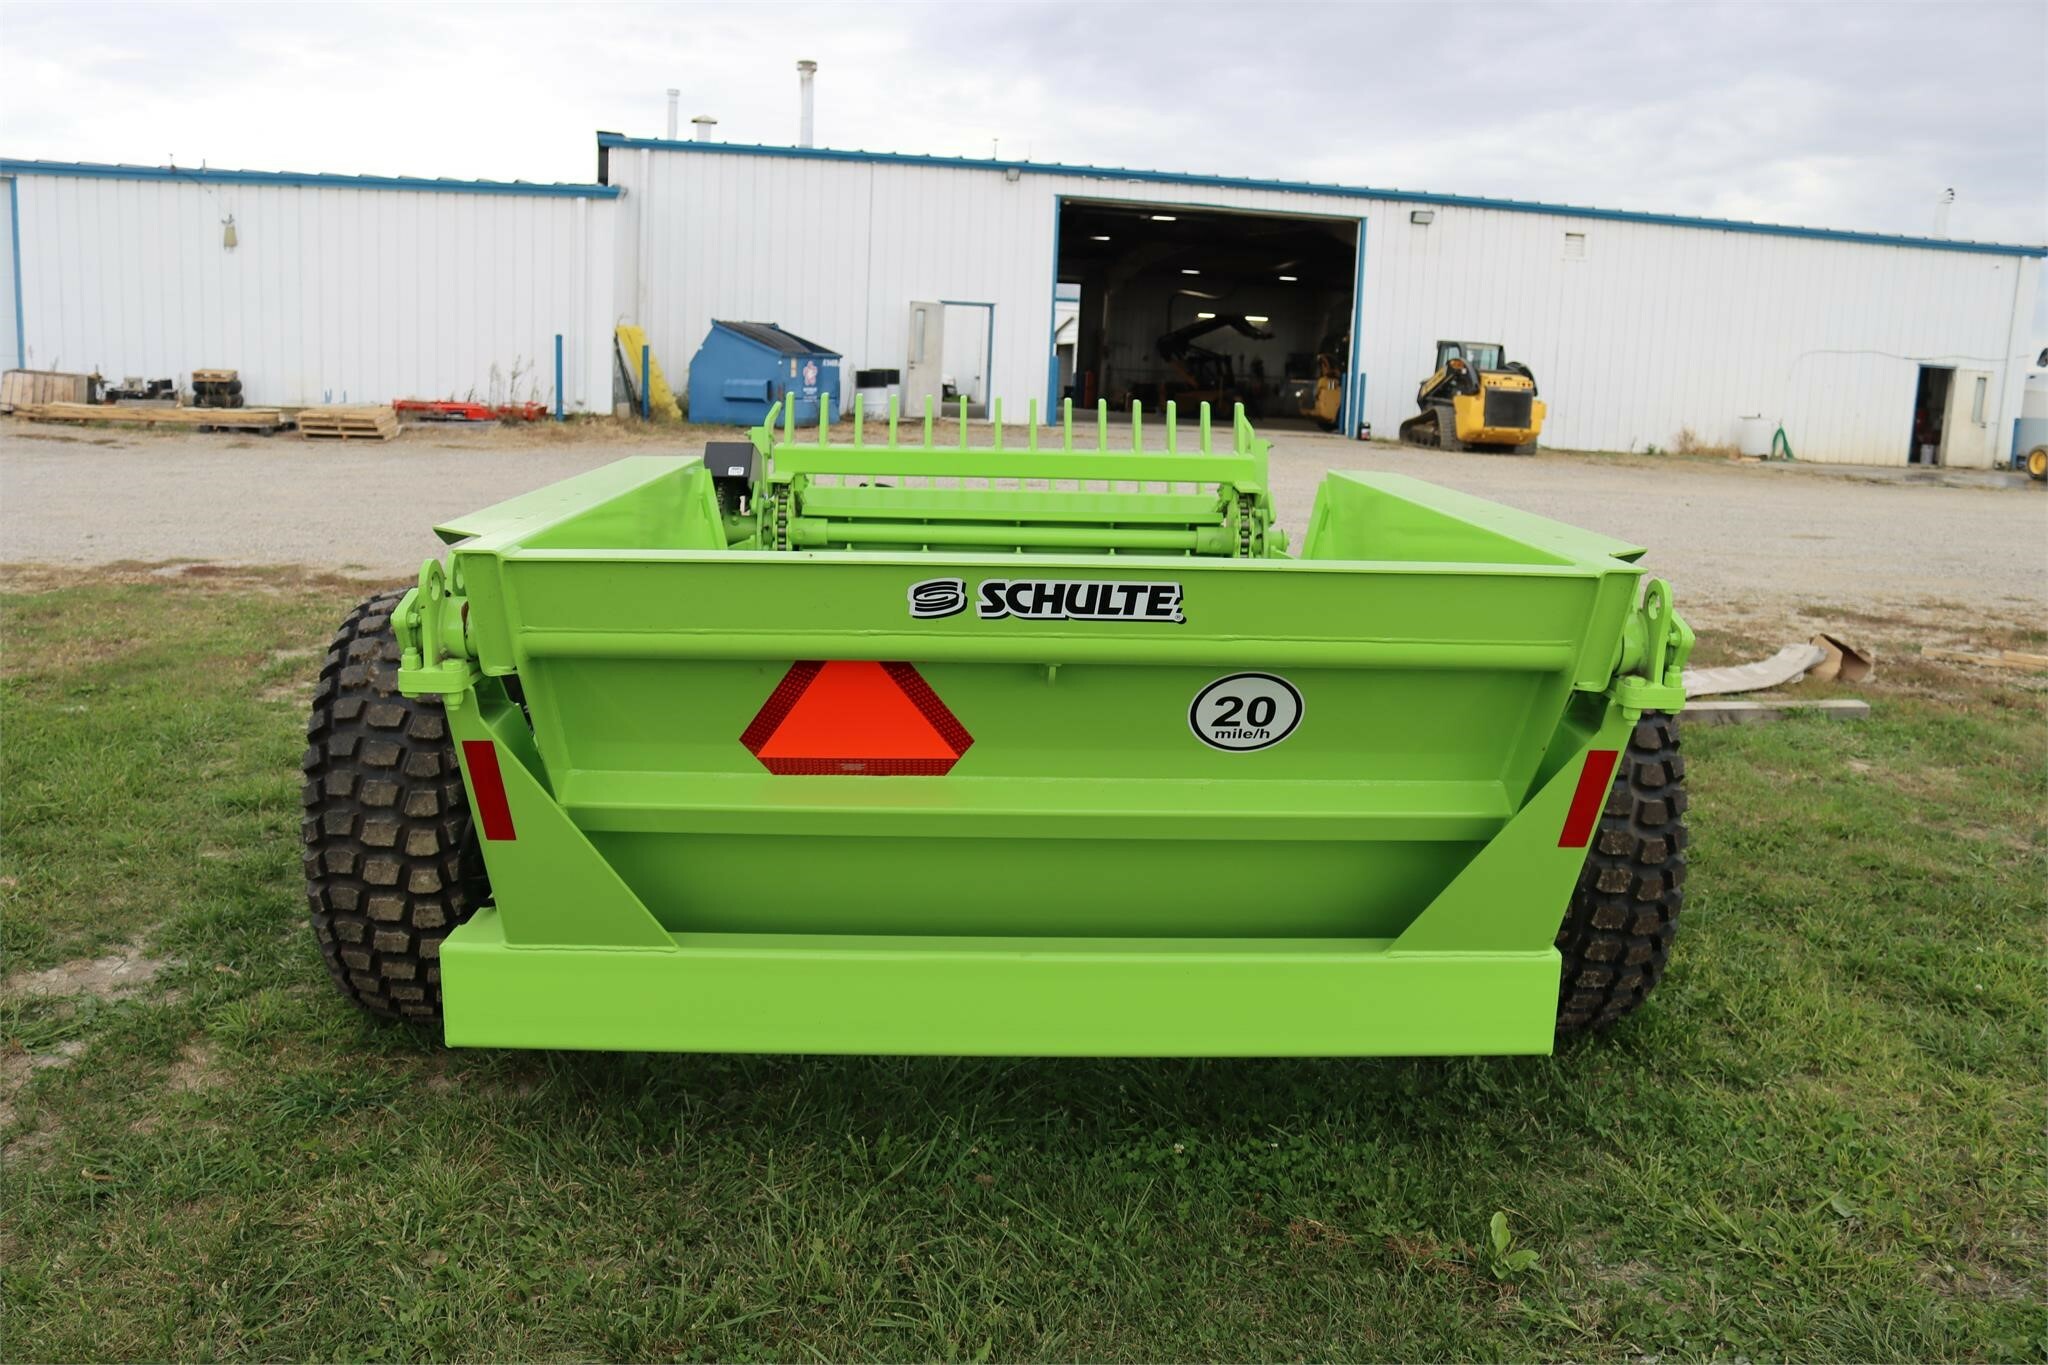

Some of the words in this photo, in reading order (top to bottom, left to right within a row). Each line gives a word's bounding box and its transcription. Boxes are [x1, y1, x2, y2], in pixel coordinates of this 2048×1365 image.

[980, 583, 1176, 616] SCHULTE
[1211, 696, 1277, 727] 20
[1215, 728, 1271, 739] mile/h
